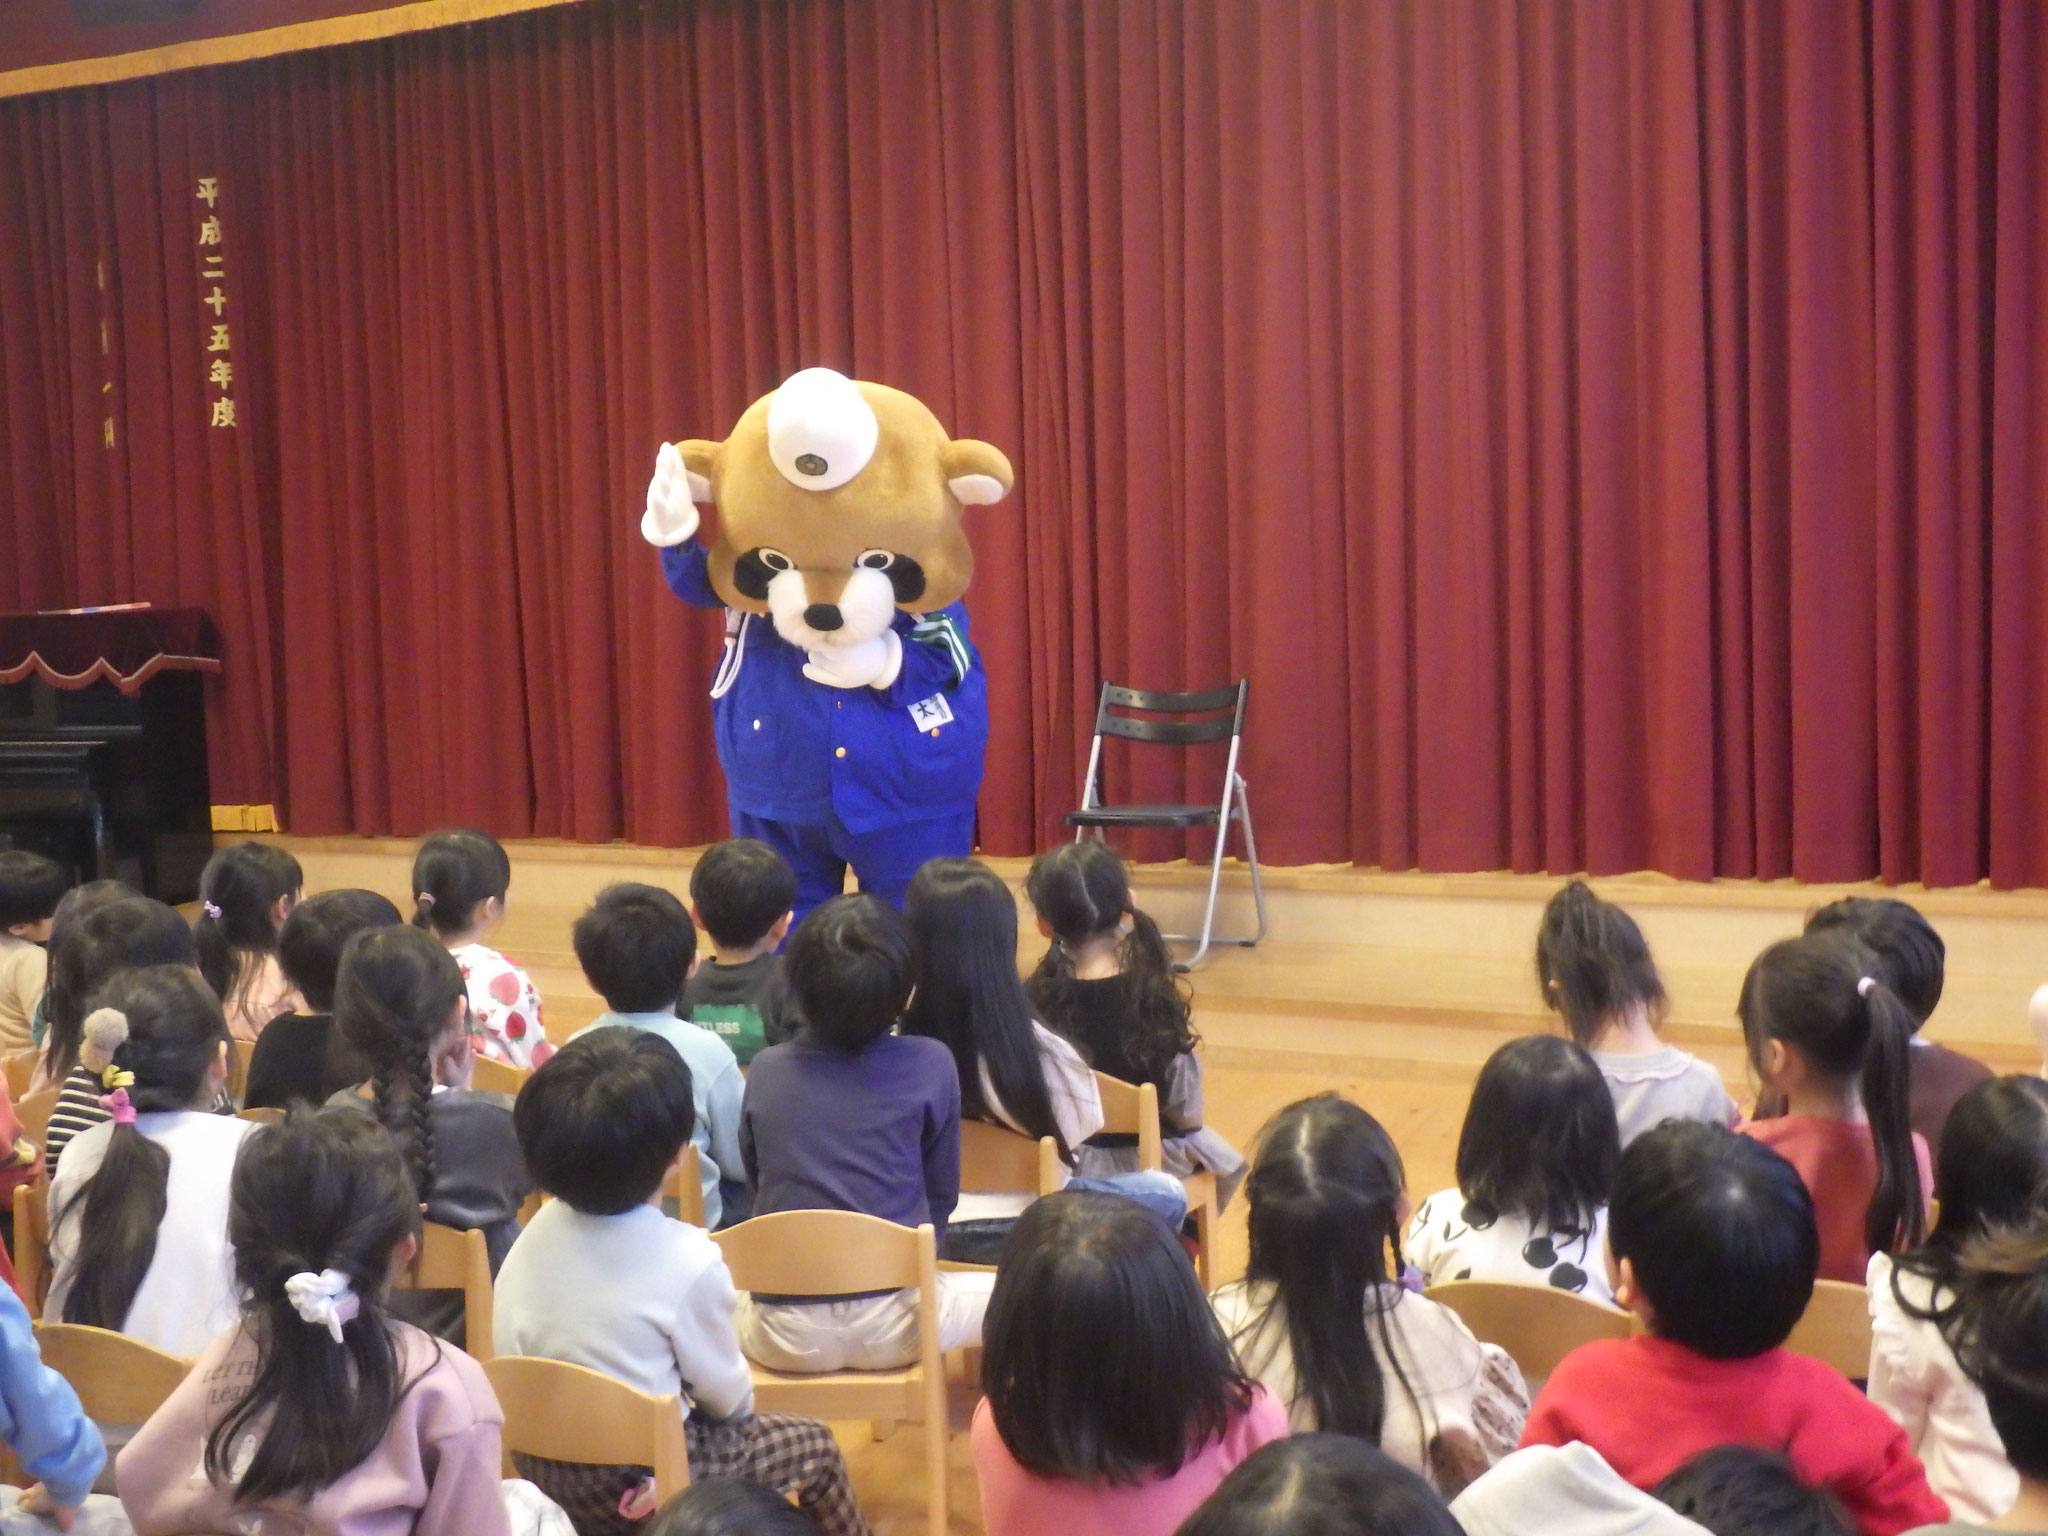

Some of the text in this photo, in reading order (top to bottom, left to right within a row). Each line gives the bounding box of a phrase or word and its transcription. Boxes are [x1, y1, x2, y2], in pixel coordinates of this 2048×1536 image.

[196, 176, 237, 428] 平成二十五年度
